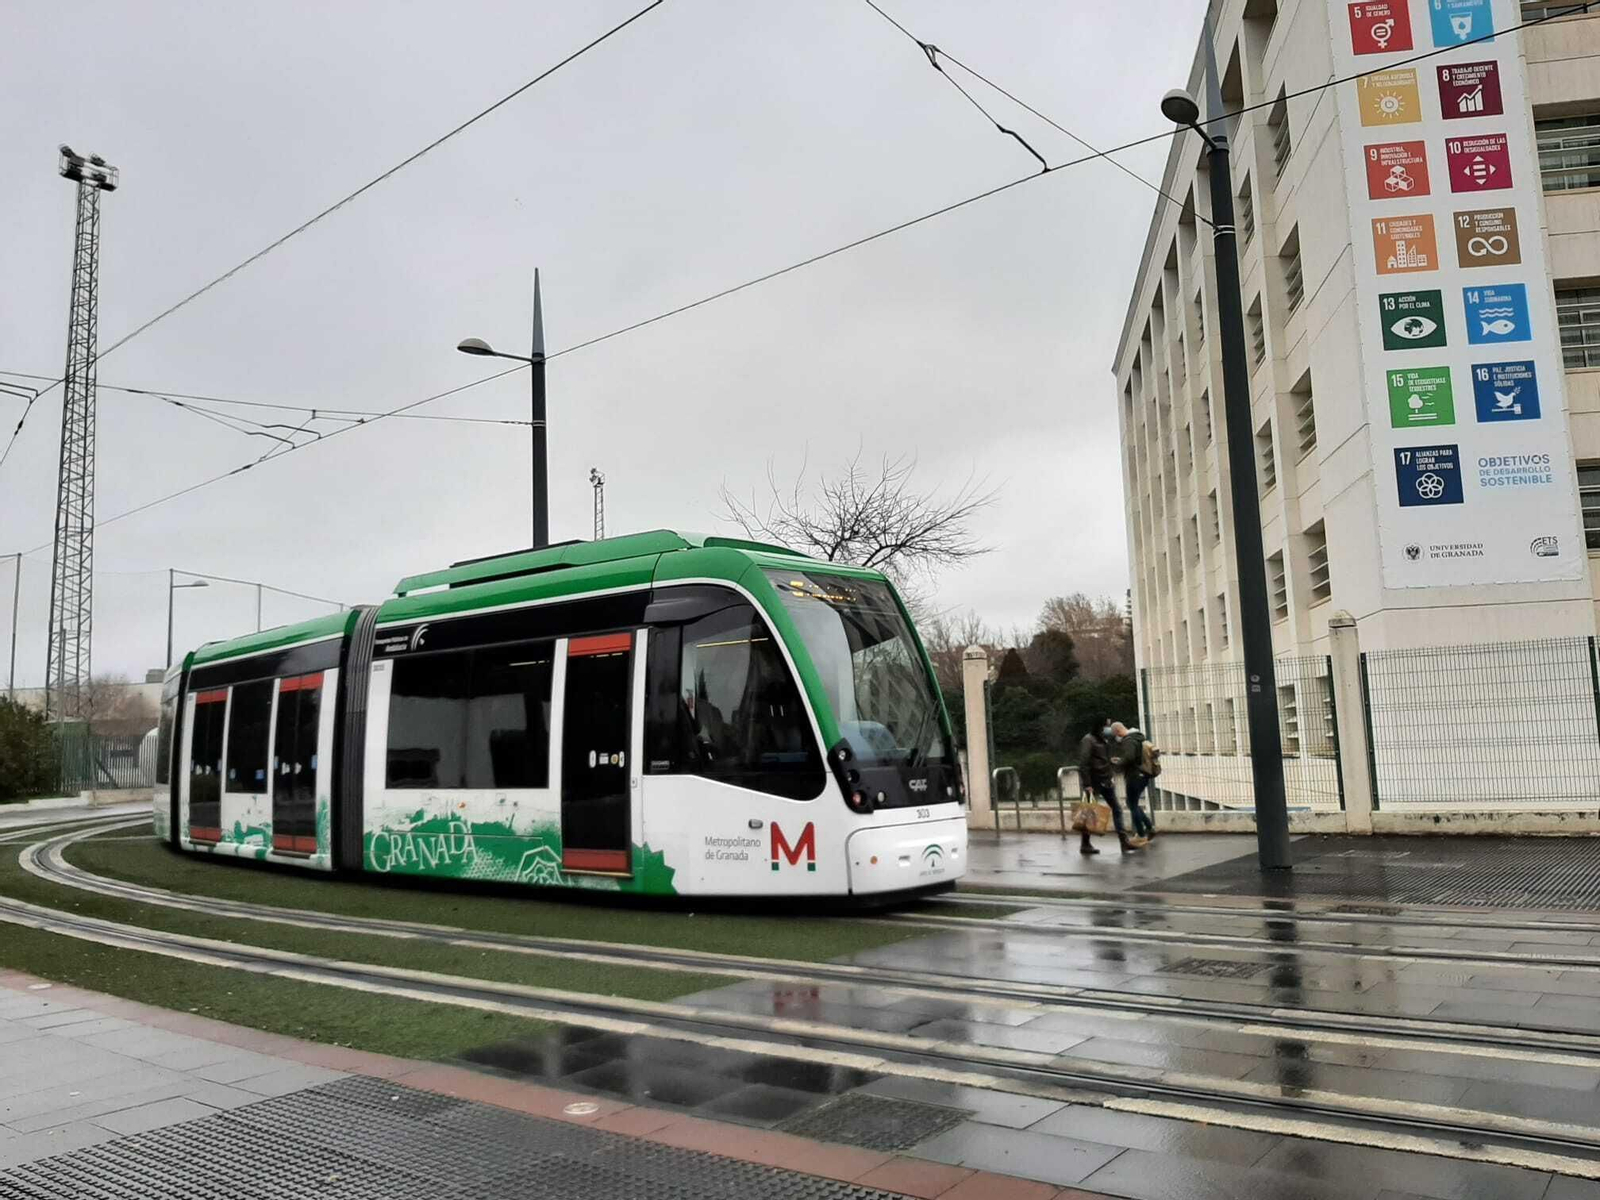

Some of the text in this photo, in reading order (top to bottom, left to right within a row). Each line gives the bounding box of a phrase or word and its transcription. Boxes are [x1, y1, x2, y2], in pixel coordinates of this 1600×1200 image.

[1354, 6, 1362, 19] 5
[1442, 69, 1450, 82] 8
[1451, 66, 1473, 74] TRABAJO
[1362, 76, 1368, 89] 7
[1449, 141, 1462, 154] 10
[1370, 148, 1378, 161] 9
[1376, 222, 1386, 234] 11
[1458, 216, 1470, 228] 12
[1383, 298, 1396, 310] 13
[1467, 291, 1480, 304] 14
[1391, 374, 1404, 387] 15
[1476, 368, 1489, 381] 16
[1400, 452, 1410, 465] 17
[1478, 454, 1550, 468] OBJETIVOS
[1427, 462, 1454, 470] OBJETIVOS
[1493, 465, 1551, 476] DESARROLLO
[1480, 474, 1553, 487] SOSTENIBLE
[1429, 543, 1484, 552] UNIVERSIDAD
[1441, 550, 1484, 558] GRANADA
[370, 821, 479, 872] GRANADA
[704, 836, 762, 849] Metropolitano
[770, 821, 816, 872] M
[705, 849, 748, 862] de Granada
